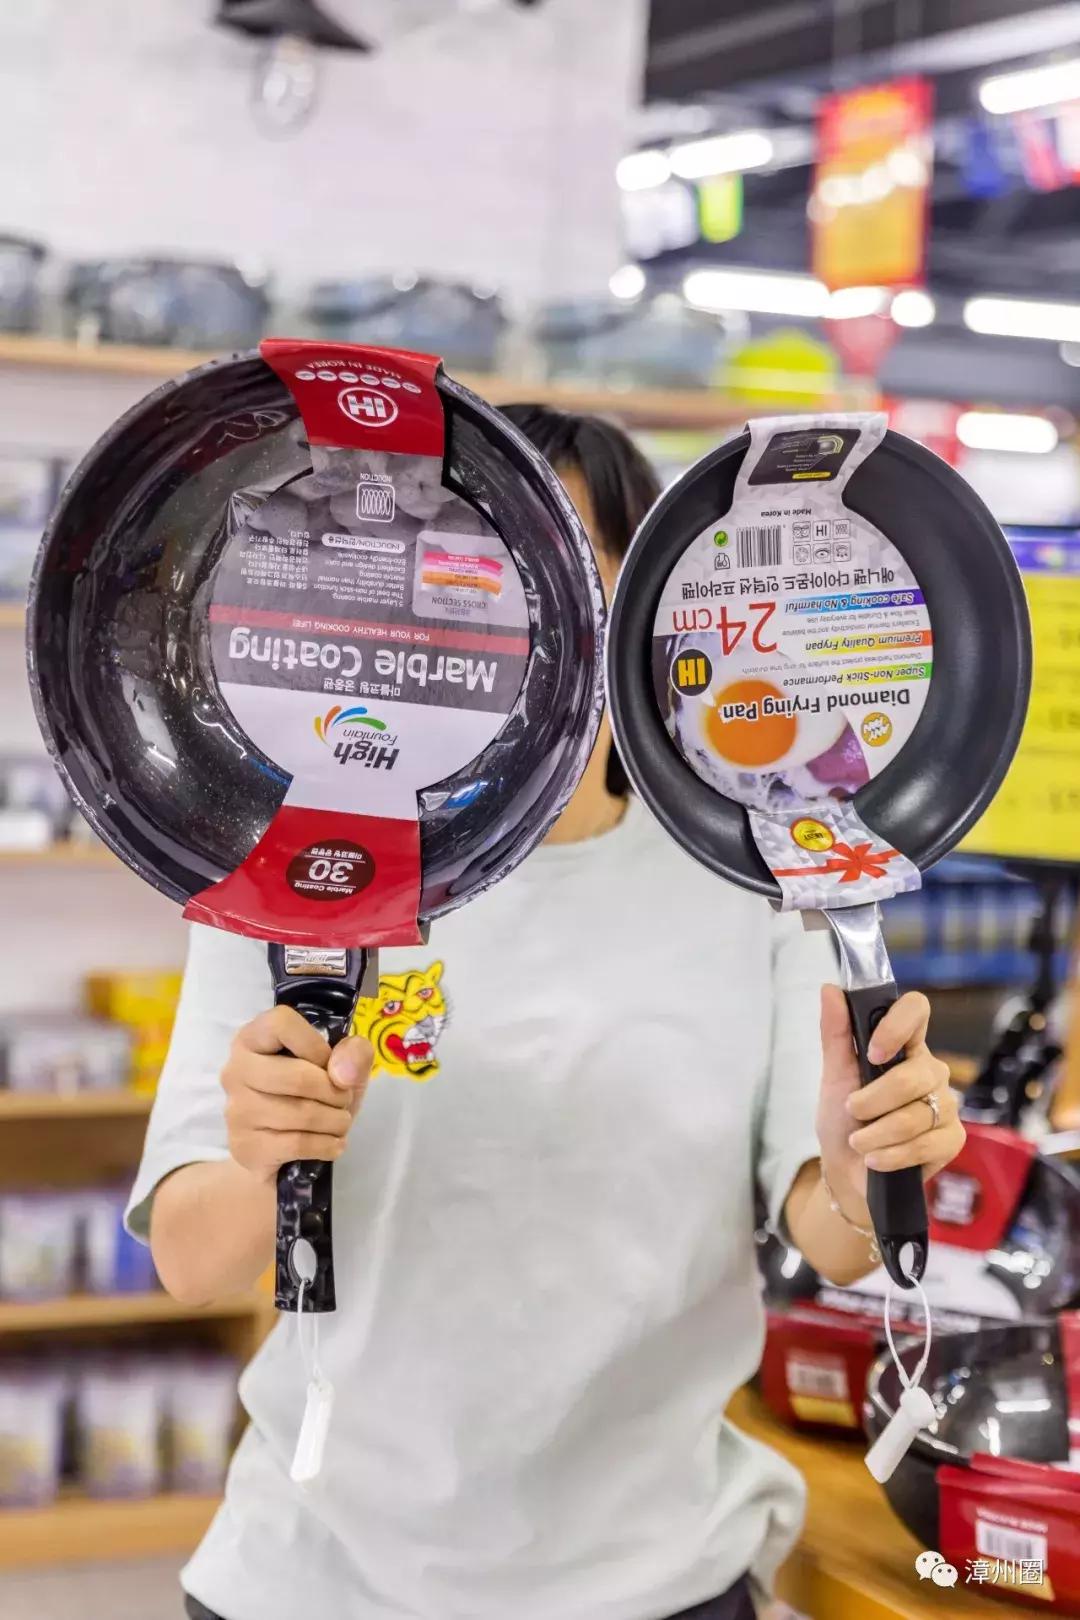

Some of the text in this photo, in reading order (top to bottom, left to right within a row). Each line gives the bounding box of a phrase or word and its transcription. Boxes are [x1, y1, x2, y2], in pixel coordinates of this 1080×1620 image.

[305, 360, 346, 368] KOREA
[365, 365, 402, 379] MADE
[347, 395, 386, 418] IH
[360, 473, 392, 483] INDUCTION
[793, 508, 811, 516] Made
[816, 524, 827, 536] IH
[377, 565, 405, 573] Excellent
[356, 579, 384, 588] durability
[681, 568, 894, 599] 애니팬 다이아몬드 인덕션 프라이팬
[340, 586, 367, 594] non-stick
[432, 597, 486, 609] CROSS SECTION
[785, 593, 913, 612] Safe cooking & No harmful
[820, 614, 847, 622] everyday
[314, 622, 350, 633] COOKING
[352, 625, 387, 637] HEALTHY
[390, 629, 411, 639] YOUR
[414, 632, 430, 641] FOR
[806, 634, 921, 651] Premium Quality Frypan
[228, 626, 497, 693] Marble Coating
[677, 658, 706, 686] IH
[783, 667, 924, 687] Super Non-Stick Performance
[323, 677, 401, 696] 마블코팅 궁중팬
[723, 689, 910, 720] Diamond Frying Pan
[343, 728, 398, 745] Fountain
[333, 741, 400, 770] High
[309, 859, 353, 883] 30
[294, 882, 325, 891] Coating
